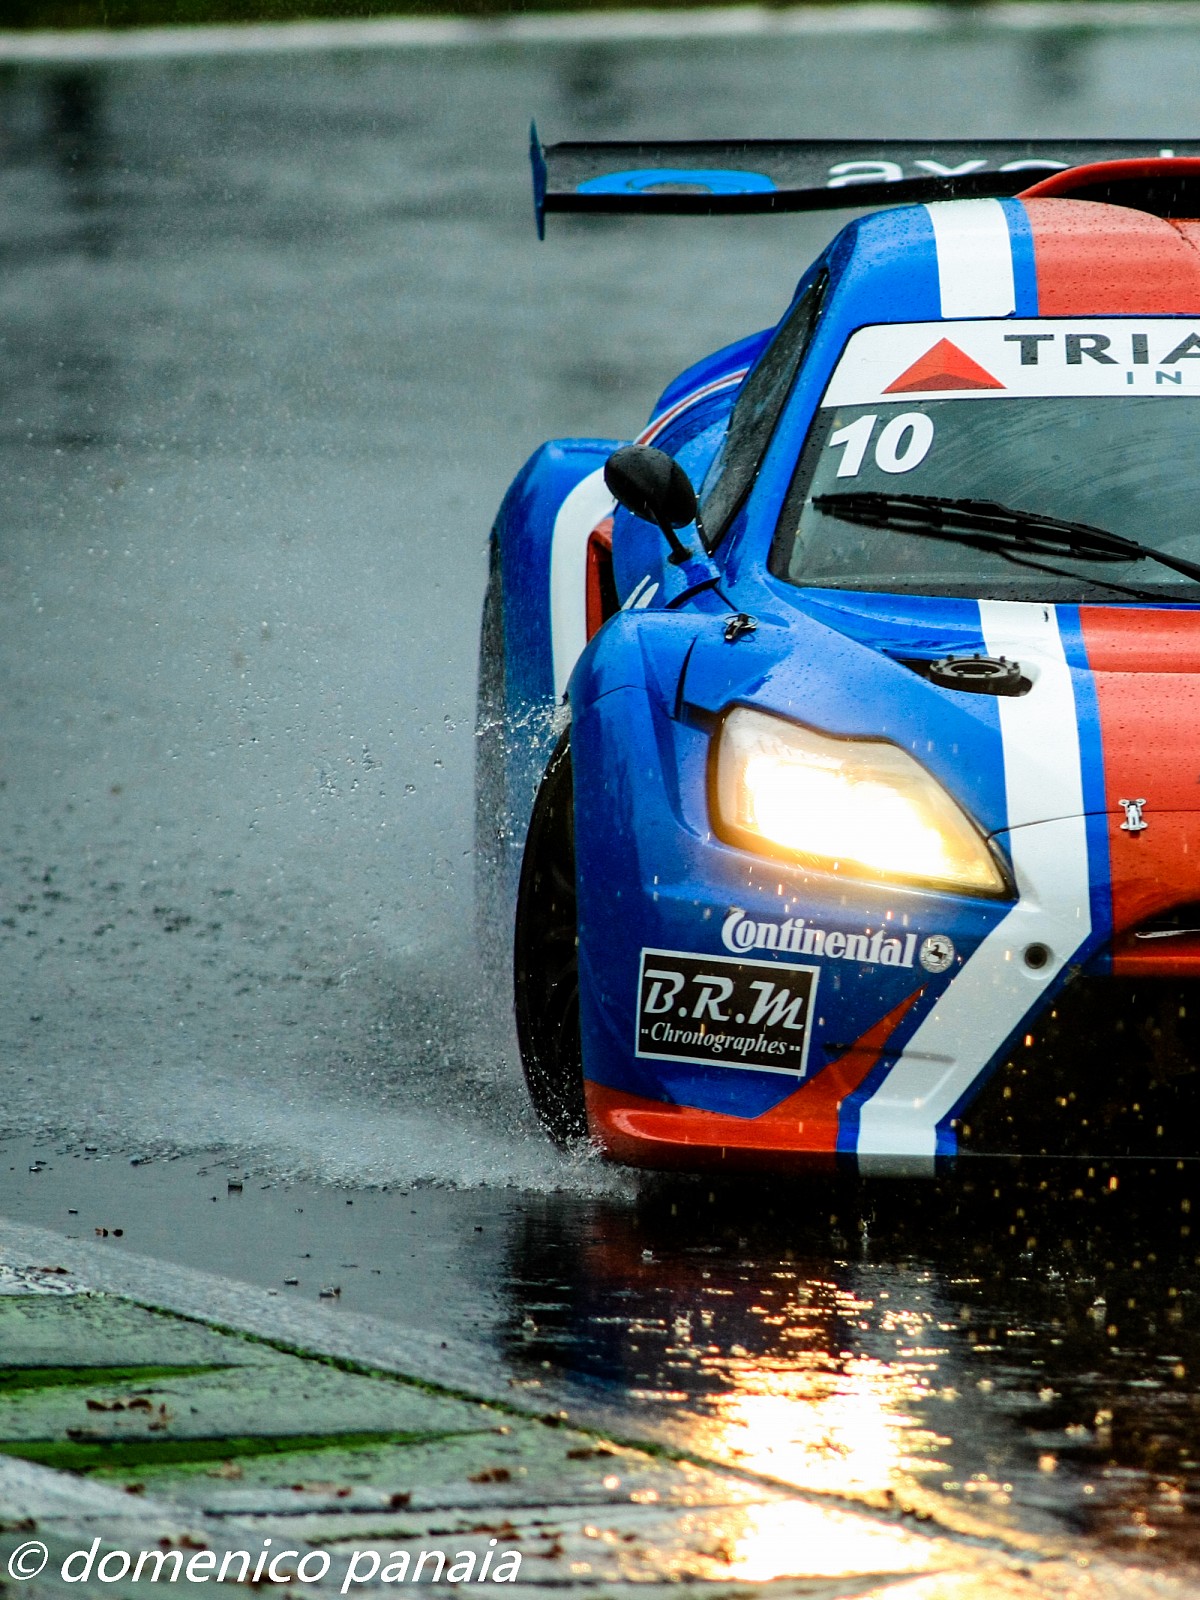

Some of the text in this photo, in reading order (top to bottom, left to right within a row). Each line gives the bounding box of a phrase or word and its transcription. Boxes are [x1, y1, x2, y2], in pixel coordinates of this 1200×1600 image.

[828, 411, 935, 479] 10
[721, 908, 918, 969] Continental
[643, 968, 805, 1030] B.R.M
